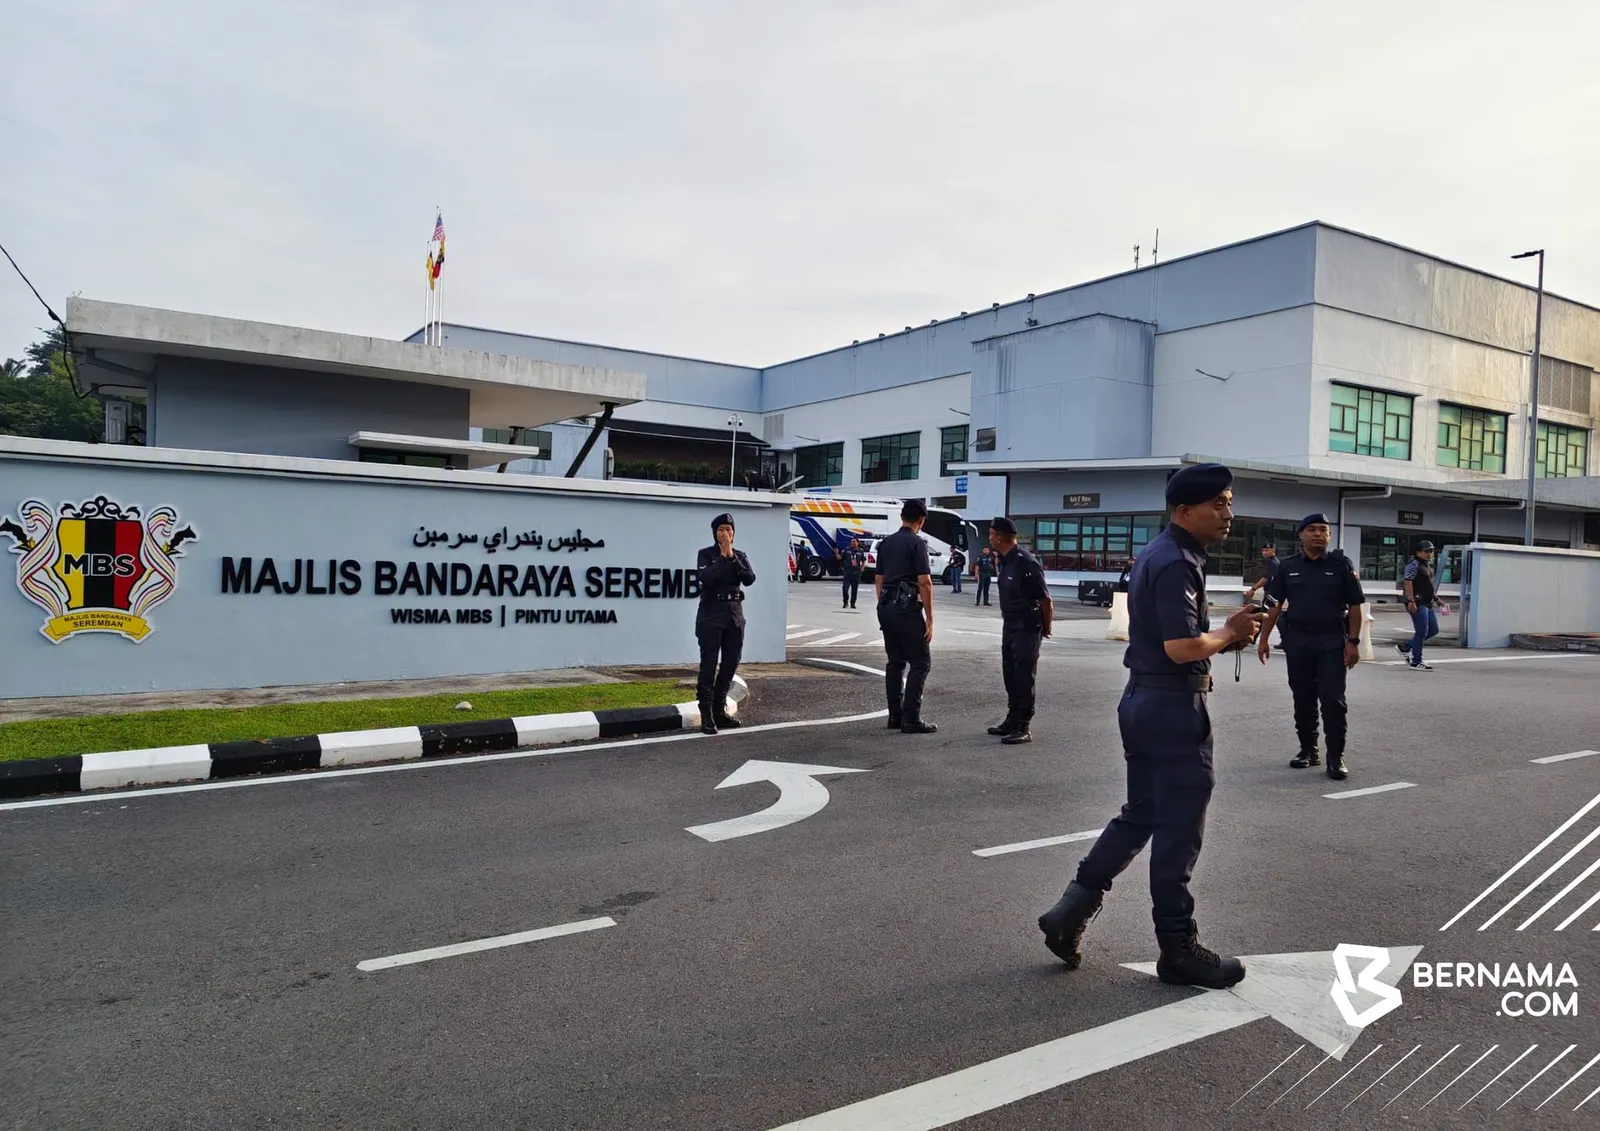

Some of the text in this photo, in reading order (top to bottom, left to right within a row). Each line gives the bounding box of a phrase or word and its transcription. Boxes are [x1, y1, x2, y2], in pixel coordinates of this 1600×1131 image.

[63, 553, 136, 577] MBS
[221, 556, 700, 599] MAJLIS BANDARAYA SEREMB
[64, 613, 132, 622] MAJLIS BANDARAYA
[73, 619, 124, 628] SEREMBAN
[390, 608, 618, 624] WISMA MBS PINTU UTAMA
